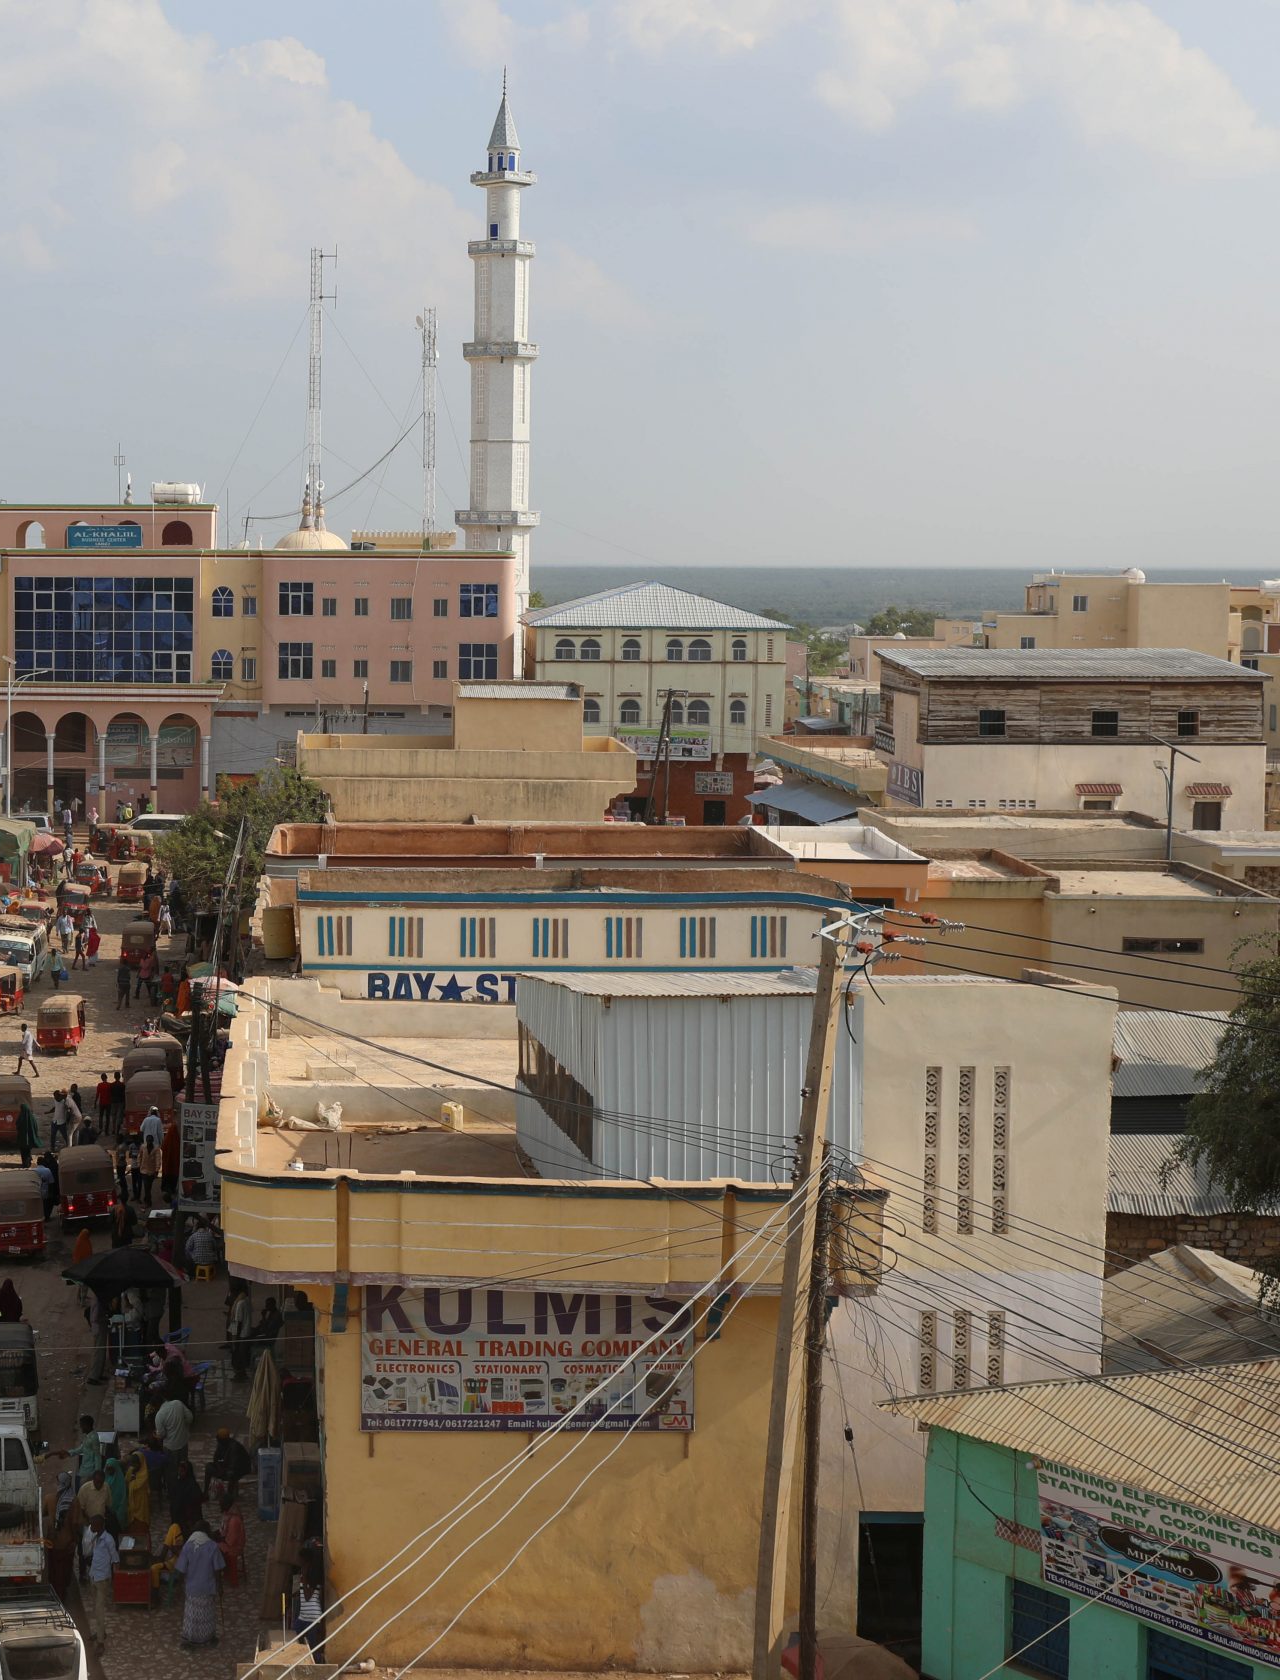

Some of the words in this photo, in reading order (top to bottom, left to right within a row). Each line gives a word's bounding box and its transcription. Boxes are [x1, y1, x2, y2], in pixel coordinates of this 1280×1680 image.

[368, 972, 436, 1000] BAY
[183, 1108, 203, 1119] BAY
[366, 1284, 692, 1335] KULMIS
[369, 1339, 468, 1357] GENERAL
[475, 1340, 573, 1357] TRADING
[581, 1340, 687, 1357] COMPANY
[376, 1363, 455, 1374] ELECTRONICS
[474, 1364, 542, 1375] STATIONARY
[366, 1418, 382, 1427] Tel:
[507, 1419, 535, 1428] Email:
[1041, 1460, 1118, 1493] MIDNIMO
[1122, 1486, 1242, 1533] ELECTRONIC
[1038, 1472, 1151, 1518] STATIONARY
[1160, 1514, 1273, 1558] COSMETICS
[1111, 1511, 1211, 1553] REPAIRING
[1127, 1548, 1194, 1577] MIDNIMO
